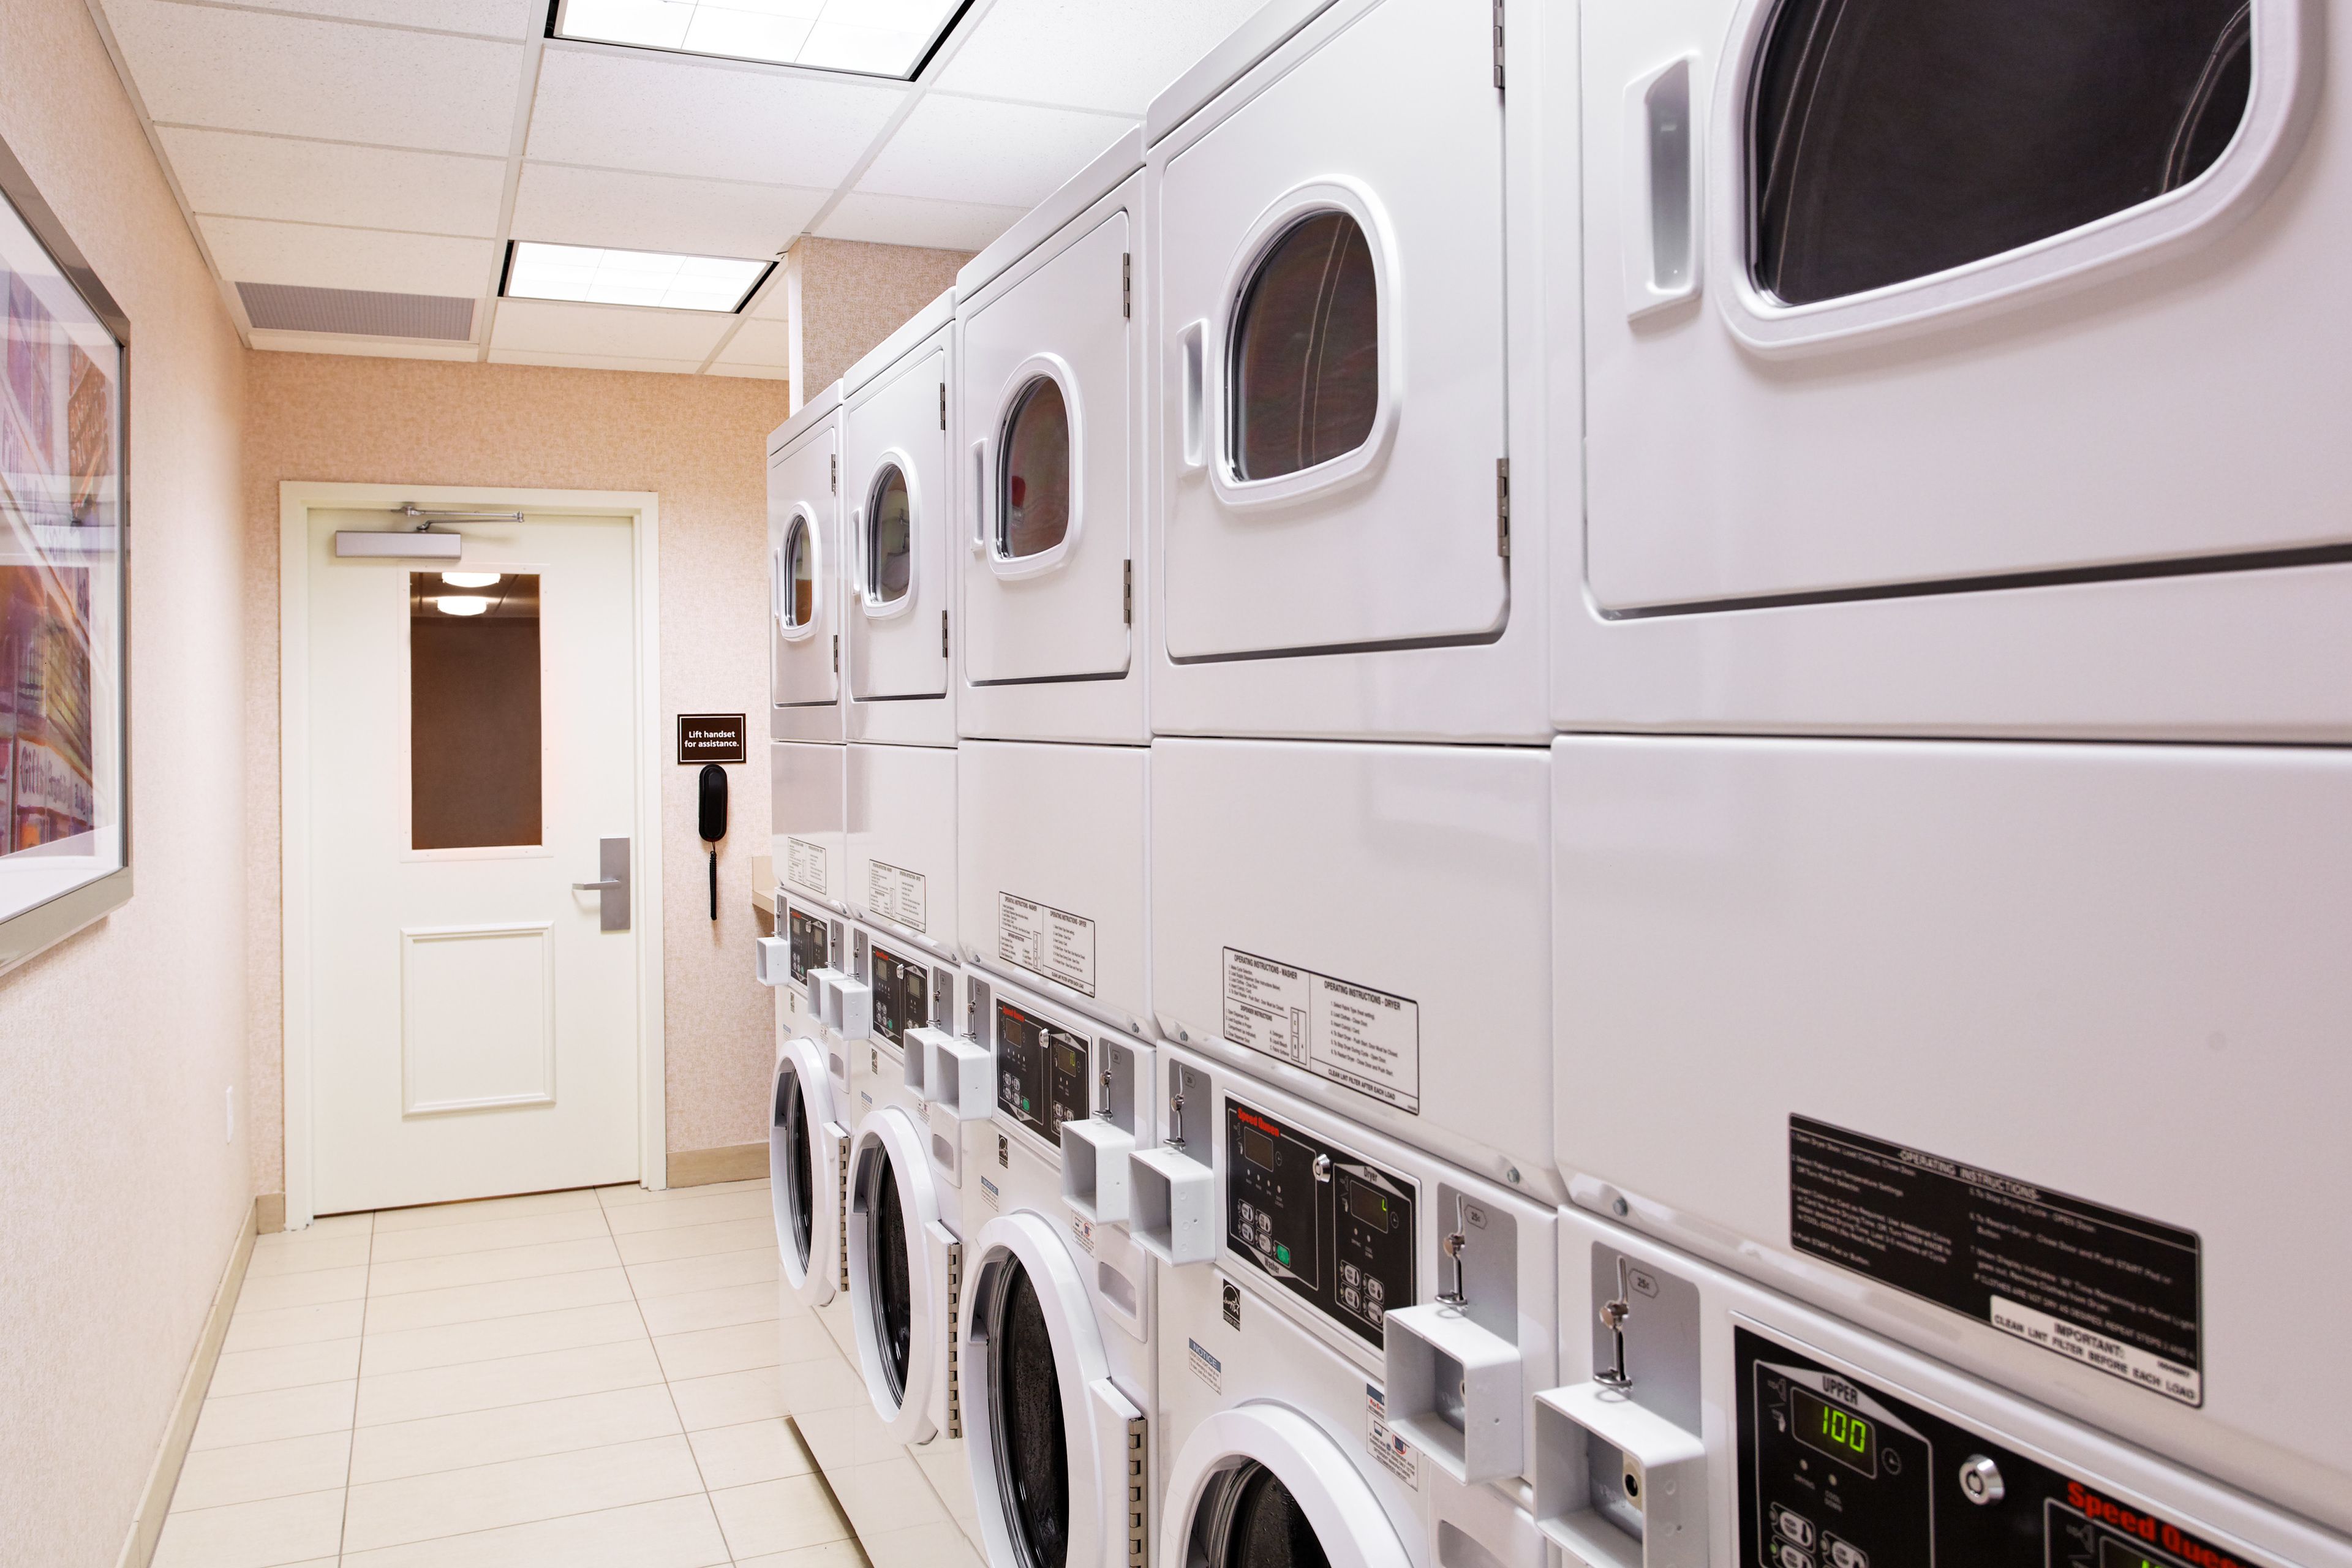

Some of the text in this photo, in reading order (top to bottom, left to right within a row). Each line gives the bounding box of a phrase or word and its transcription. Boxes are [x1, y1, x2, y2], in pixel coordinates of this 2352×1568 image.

[1234, 954, 1297, 979] OPERATING INSTRUCTIONS WASHER
[1324, 981, 1400, 1010] OPERATING INSTRUCTIONS DRYER
[1328, 1069, 1340, 1079] CLEAN
[1349, 1076, 1360, 1087] FILTER
[1361, 1080, 1373, 1091] AFTER
[1374, 1085, 1384, 1095] EACH
[1384, 1089, 1395, 1099] LOAD
[1237, 1107, 1280, 1137] Speed Queen
[1363, 1167, 1378, 1182] Dryer
[1264, 1256, 1279, 1274] Washer
[1637, 1278, 1649, 1289] 25¢
[1193, 1343, 1217, 1368] NOTICE
[2054, 1322, 2125, 1359] IMPORTANT:
[1994, 1313, 2024, 1335] CLEAN
[2027, 1326, 2047, 1344] LINT
[2052, 1335, 2083, 1358] FILTER
[2087, 1349, 2128, 1374] BEFORE
[2132, 1366, 2161, 1387] EACH
[2165, 1378, 2195, 1400] LOAD
[1822, 1375, 1858, 1406] UPPER
[1822, 1405, 1866, 1453] 100
[2067, 1480, 2246, 1568] Speed Quee
